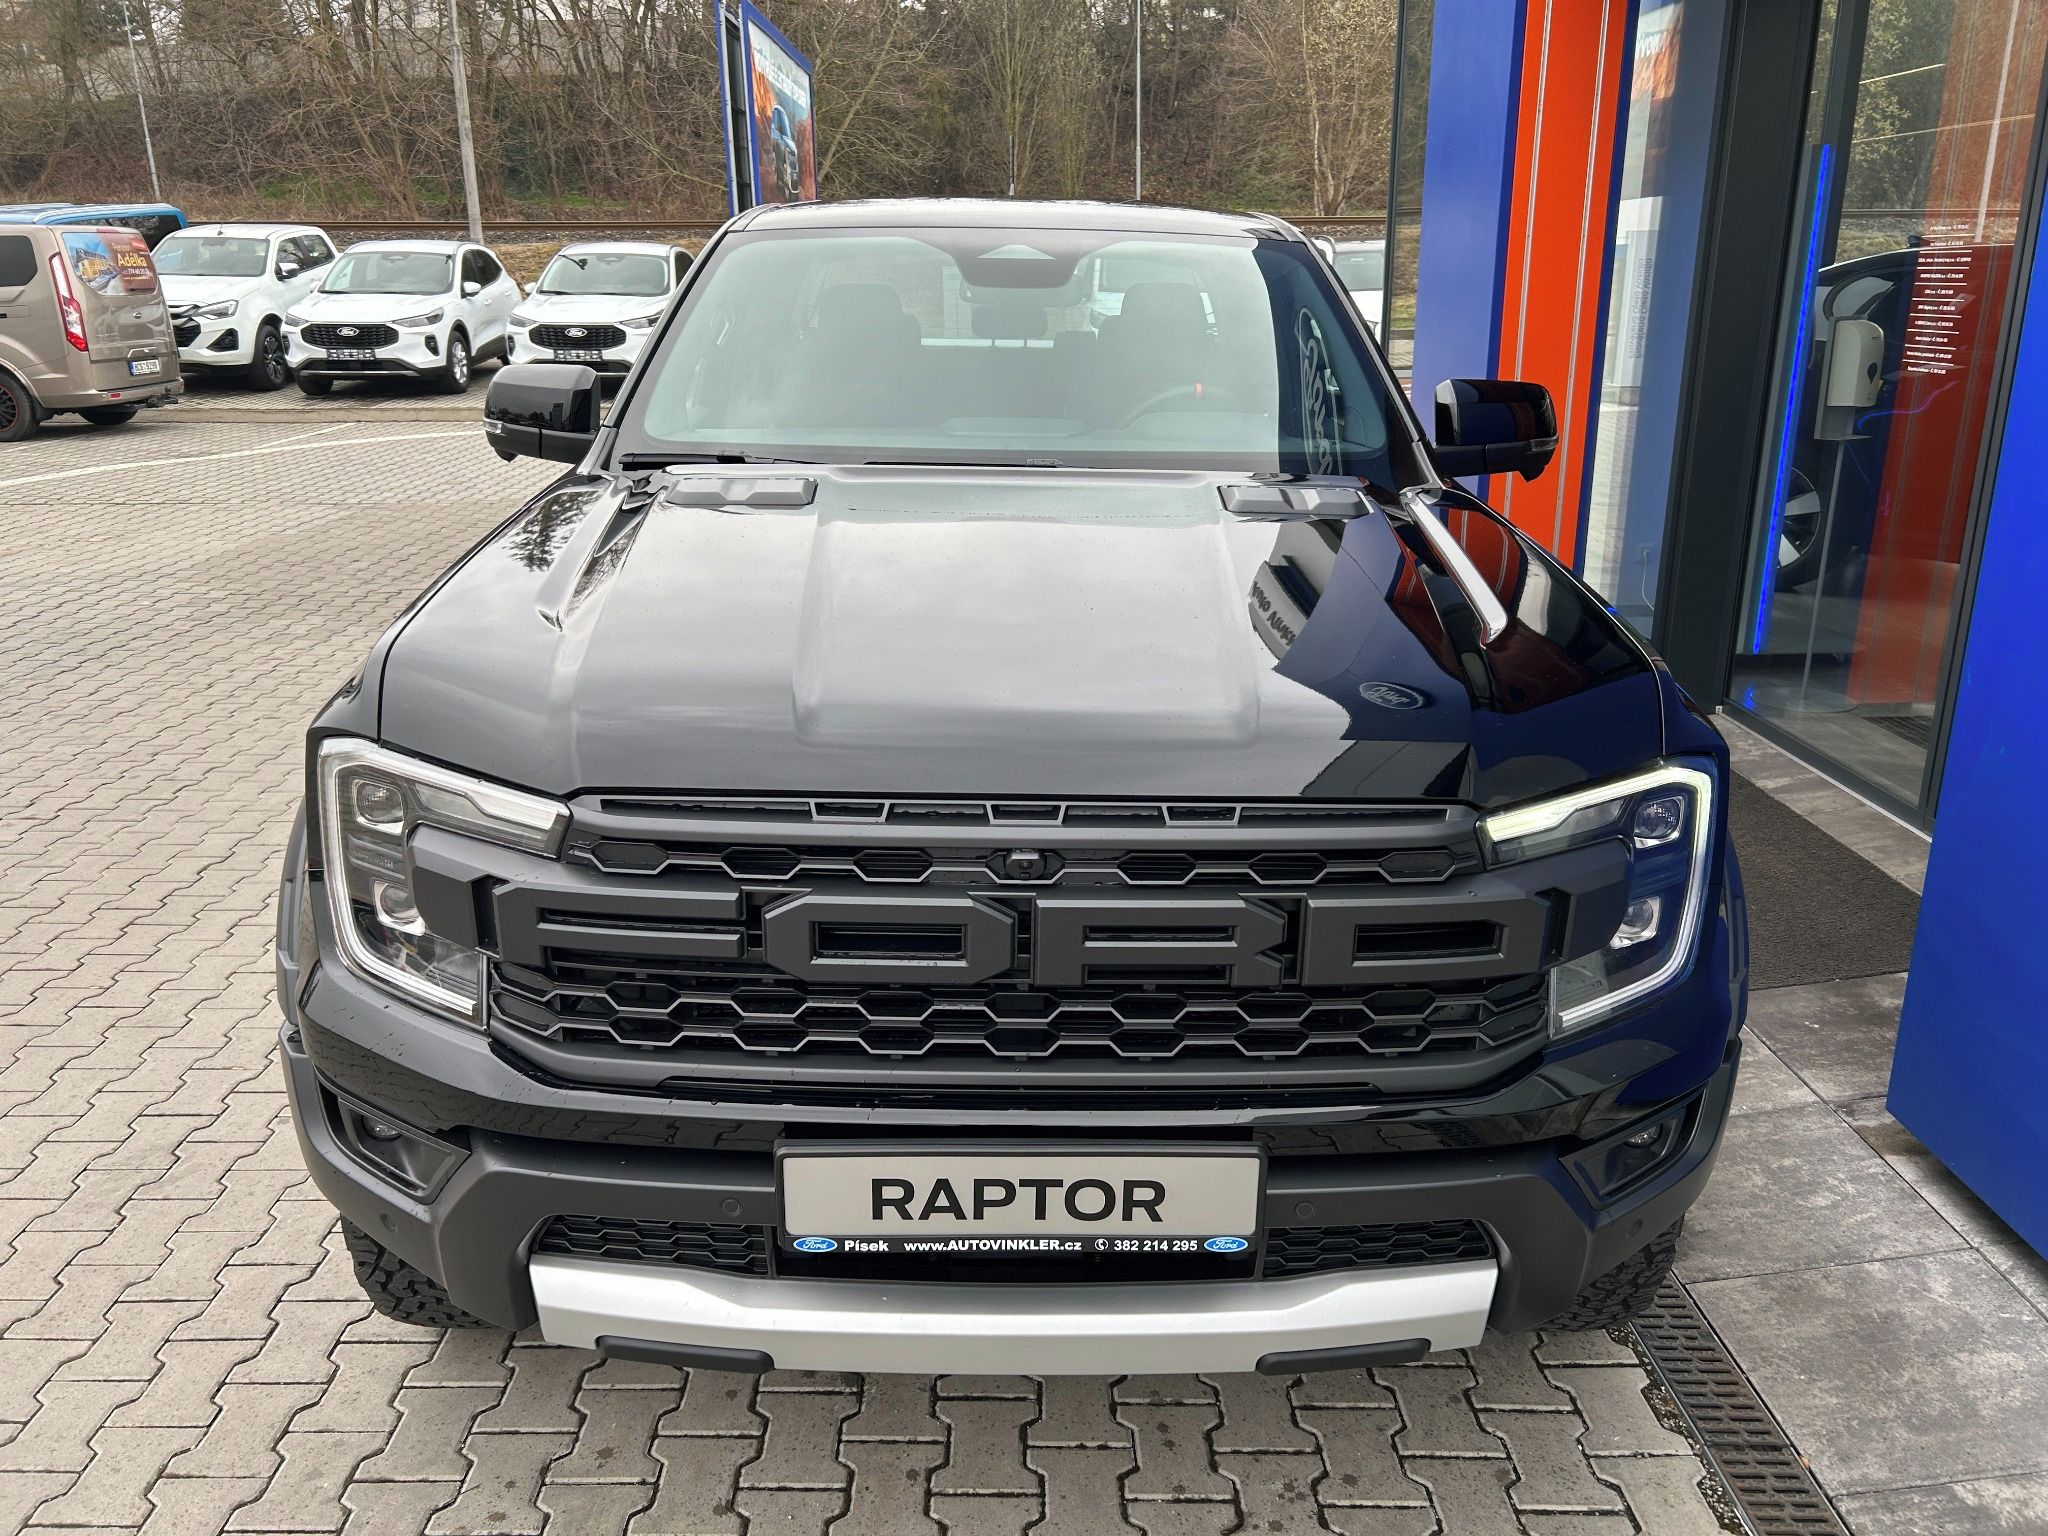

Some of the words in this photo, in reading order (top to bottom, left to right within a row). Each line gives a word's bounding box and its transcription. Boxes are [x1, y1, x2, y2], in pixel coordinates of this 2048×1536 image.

[492, 886, 1556, 987] FORD
[870, 1178, 1167, 1222] RAPTOR
[844, 1240, 889, 1252] Písek
[904, 1239, 1082, 1252] www.AUTOVINKLER.cz
[1113, 1240, 1139, 1252] 382
[1144, 1240, 1169, 1252] 214
[1172, 1240, 1198, 1252] 295
